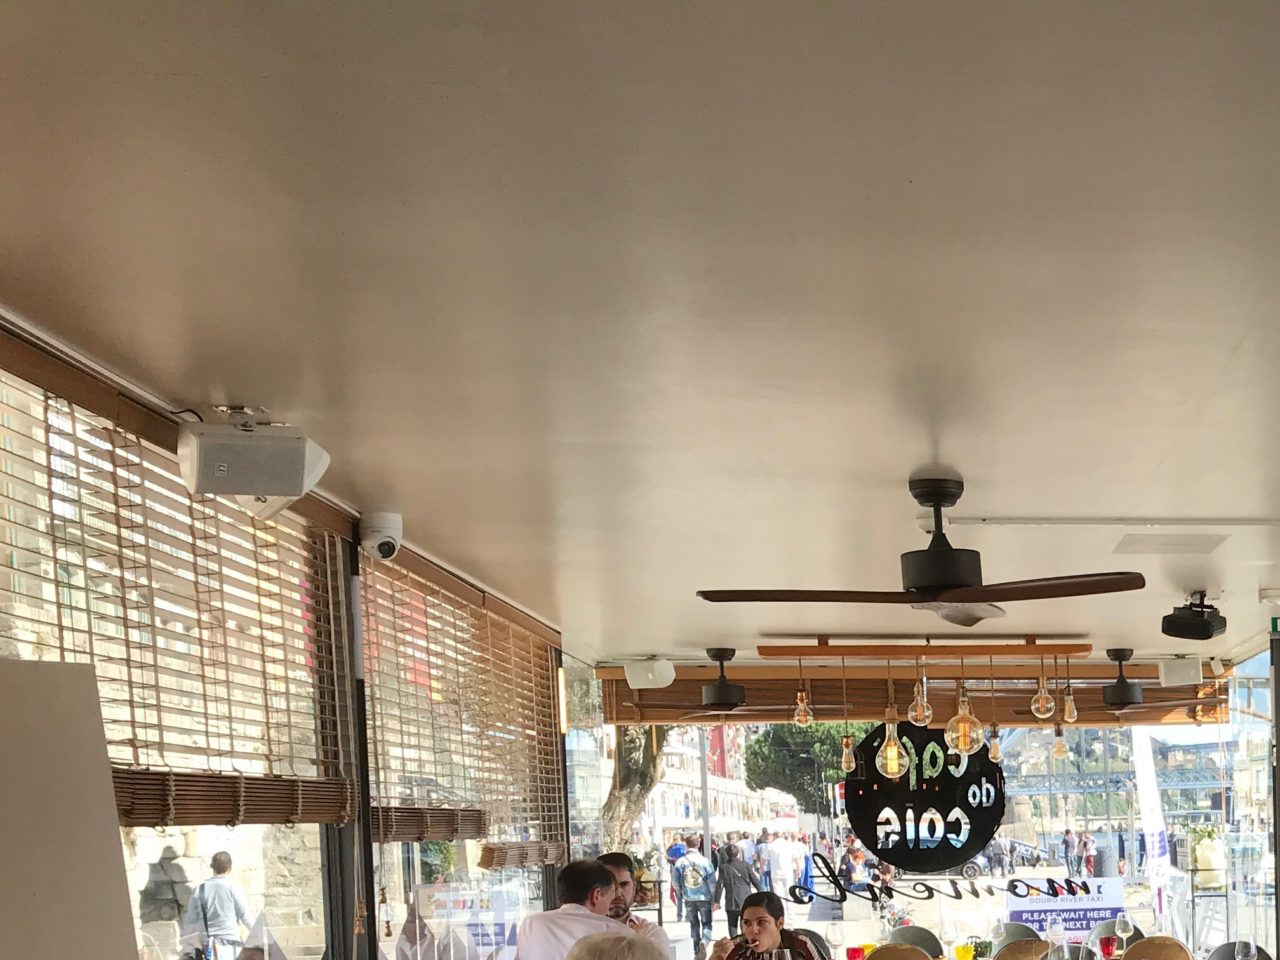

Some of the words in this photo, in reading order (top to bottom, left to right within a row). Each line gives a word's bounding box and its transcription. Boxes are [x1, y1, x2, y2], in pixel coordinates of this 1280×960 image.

[1060, 895, 1084, 903] RIVER
[1086, 895, 1104, 903] TAXI
[1022, 911, 1058, 921] PLEASE
[1060, 910, 1084, 920] WAIT
[1086, 910, 1112, 919] HERE
[1063, 920, 1087, 929] NEXT
